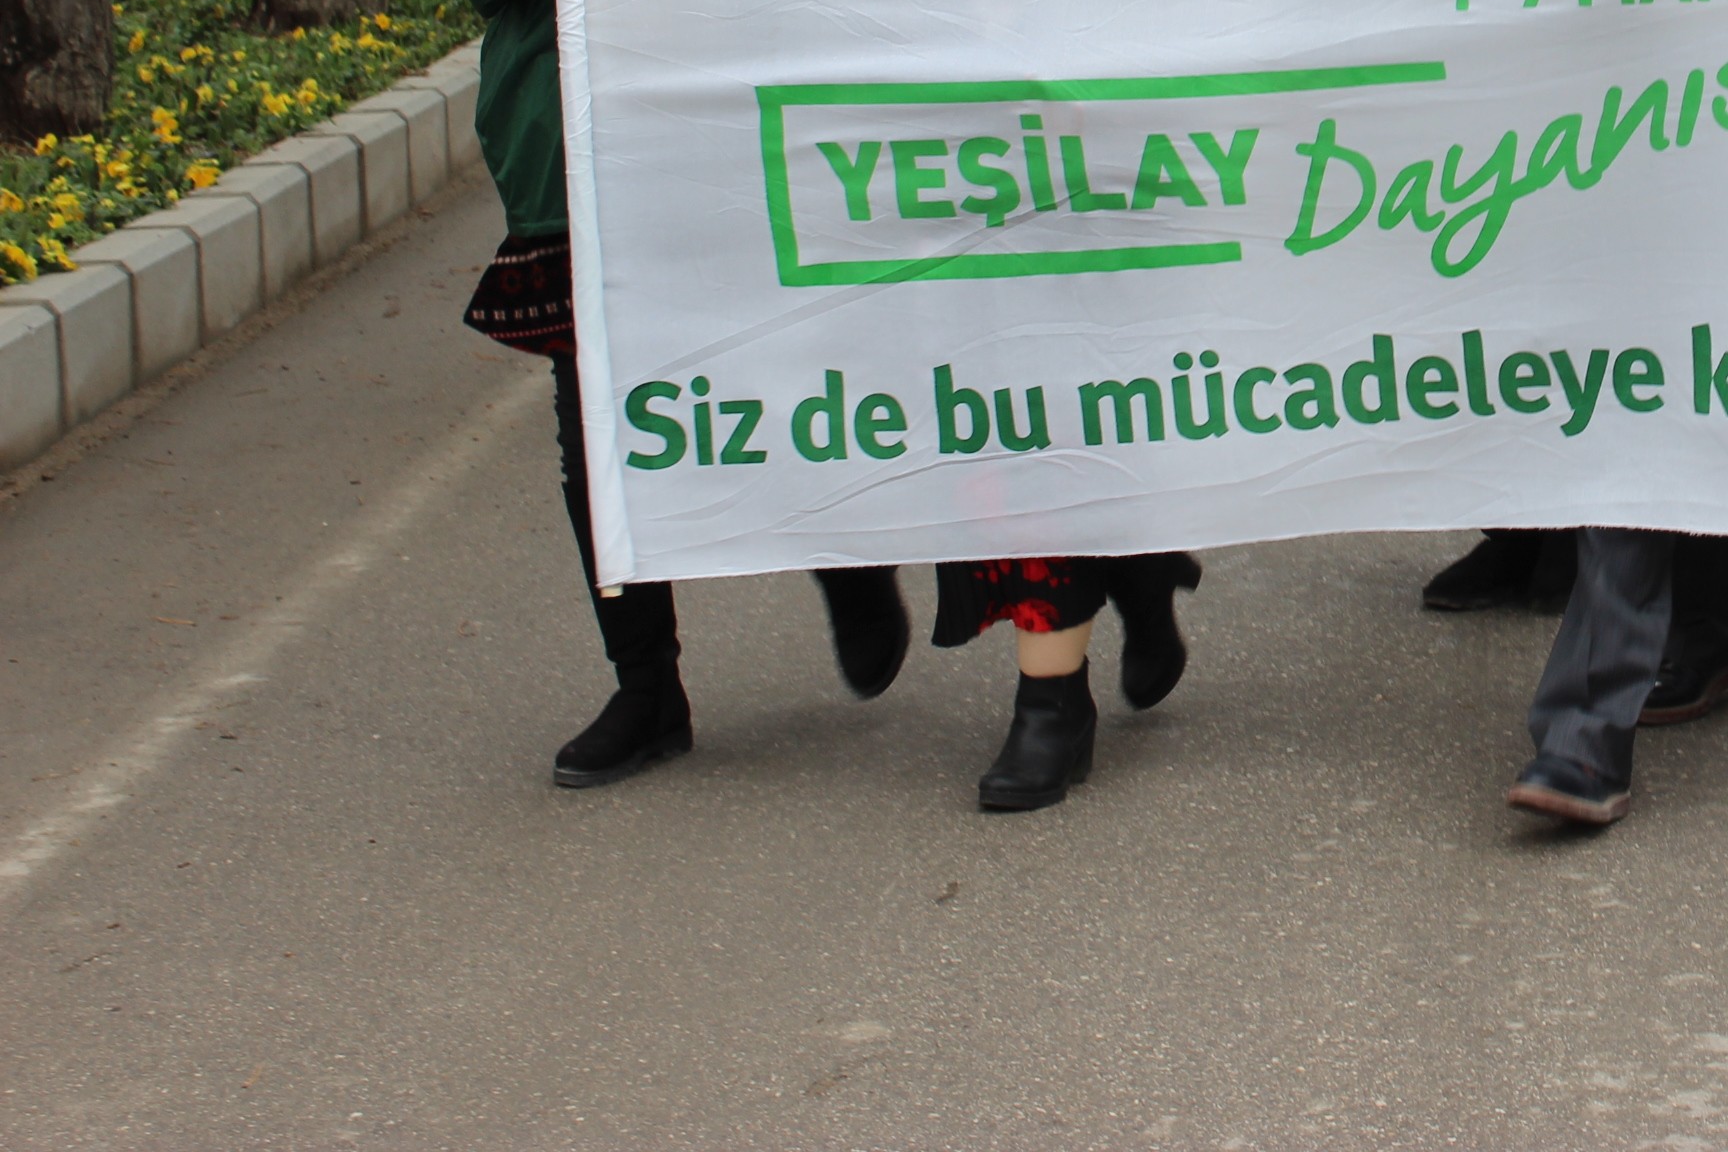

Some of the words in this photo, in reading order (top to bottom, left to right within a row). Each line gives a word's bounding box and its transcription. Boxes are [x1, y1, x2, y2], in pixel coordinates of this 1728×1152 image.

[816, 114, 1261, 229] YEŞİLAY
[626, 376, 766, 470] Siz
[792, 369, 907, 463] de
[934, 364, 1051, 454] bu
[1079, 330, 1665, 446] mücadeleye
